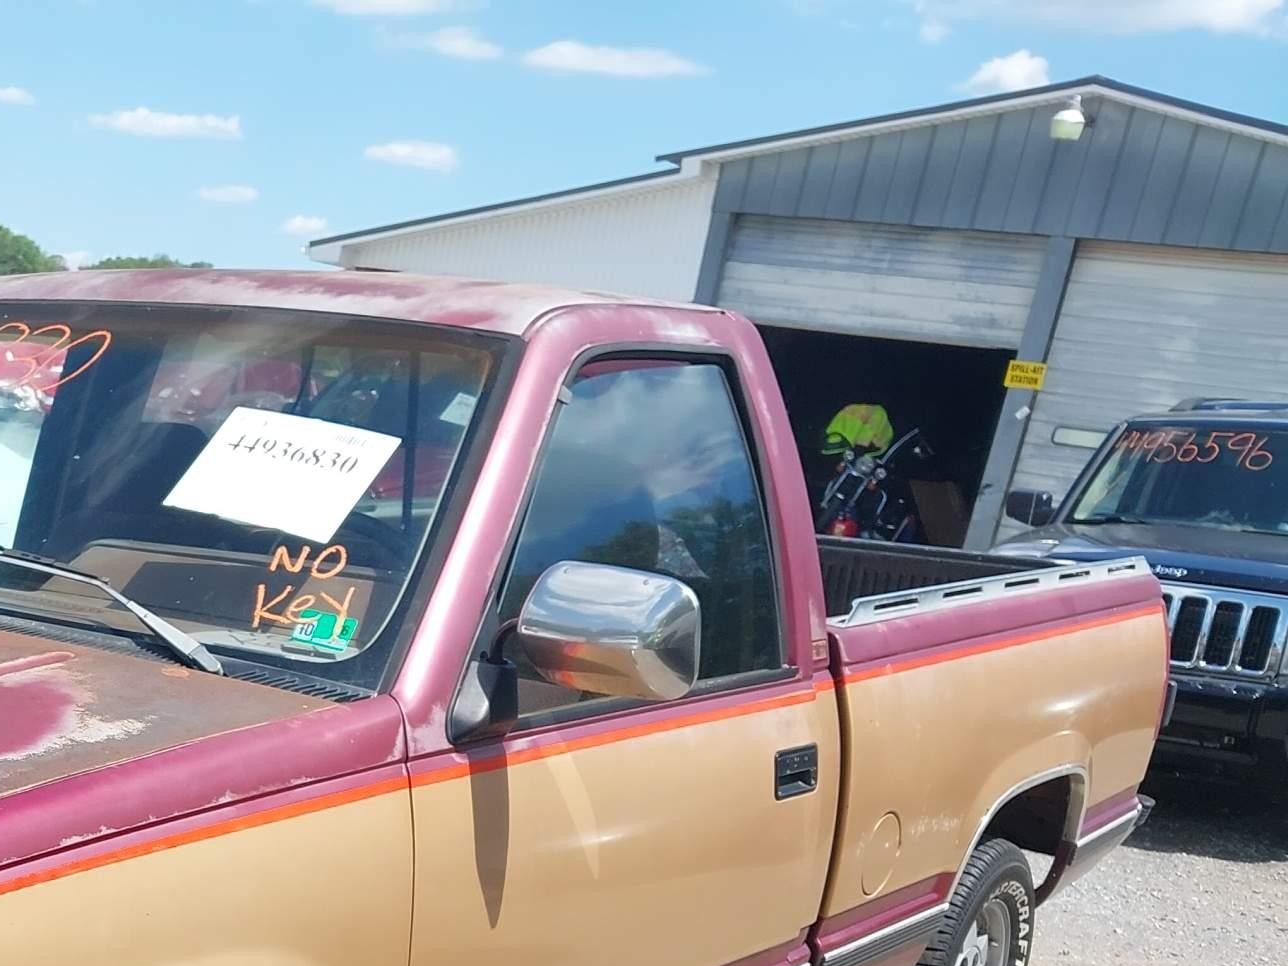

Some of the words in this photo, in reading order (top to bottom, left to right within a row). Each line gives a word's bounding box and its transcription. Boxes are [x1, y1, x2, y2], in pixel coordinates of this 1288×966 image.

[1009, 374, 1038, 385] STATION
[227, 434, 359, 474] 44936830
[269, 544, 348, 579] NO
